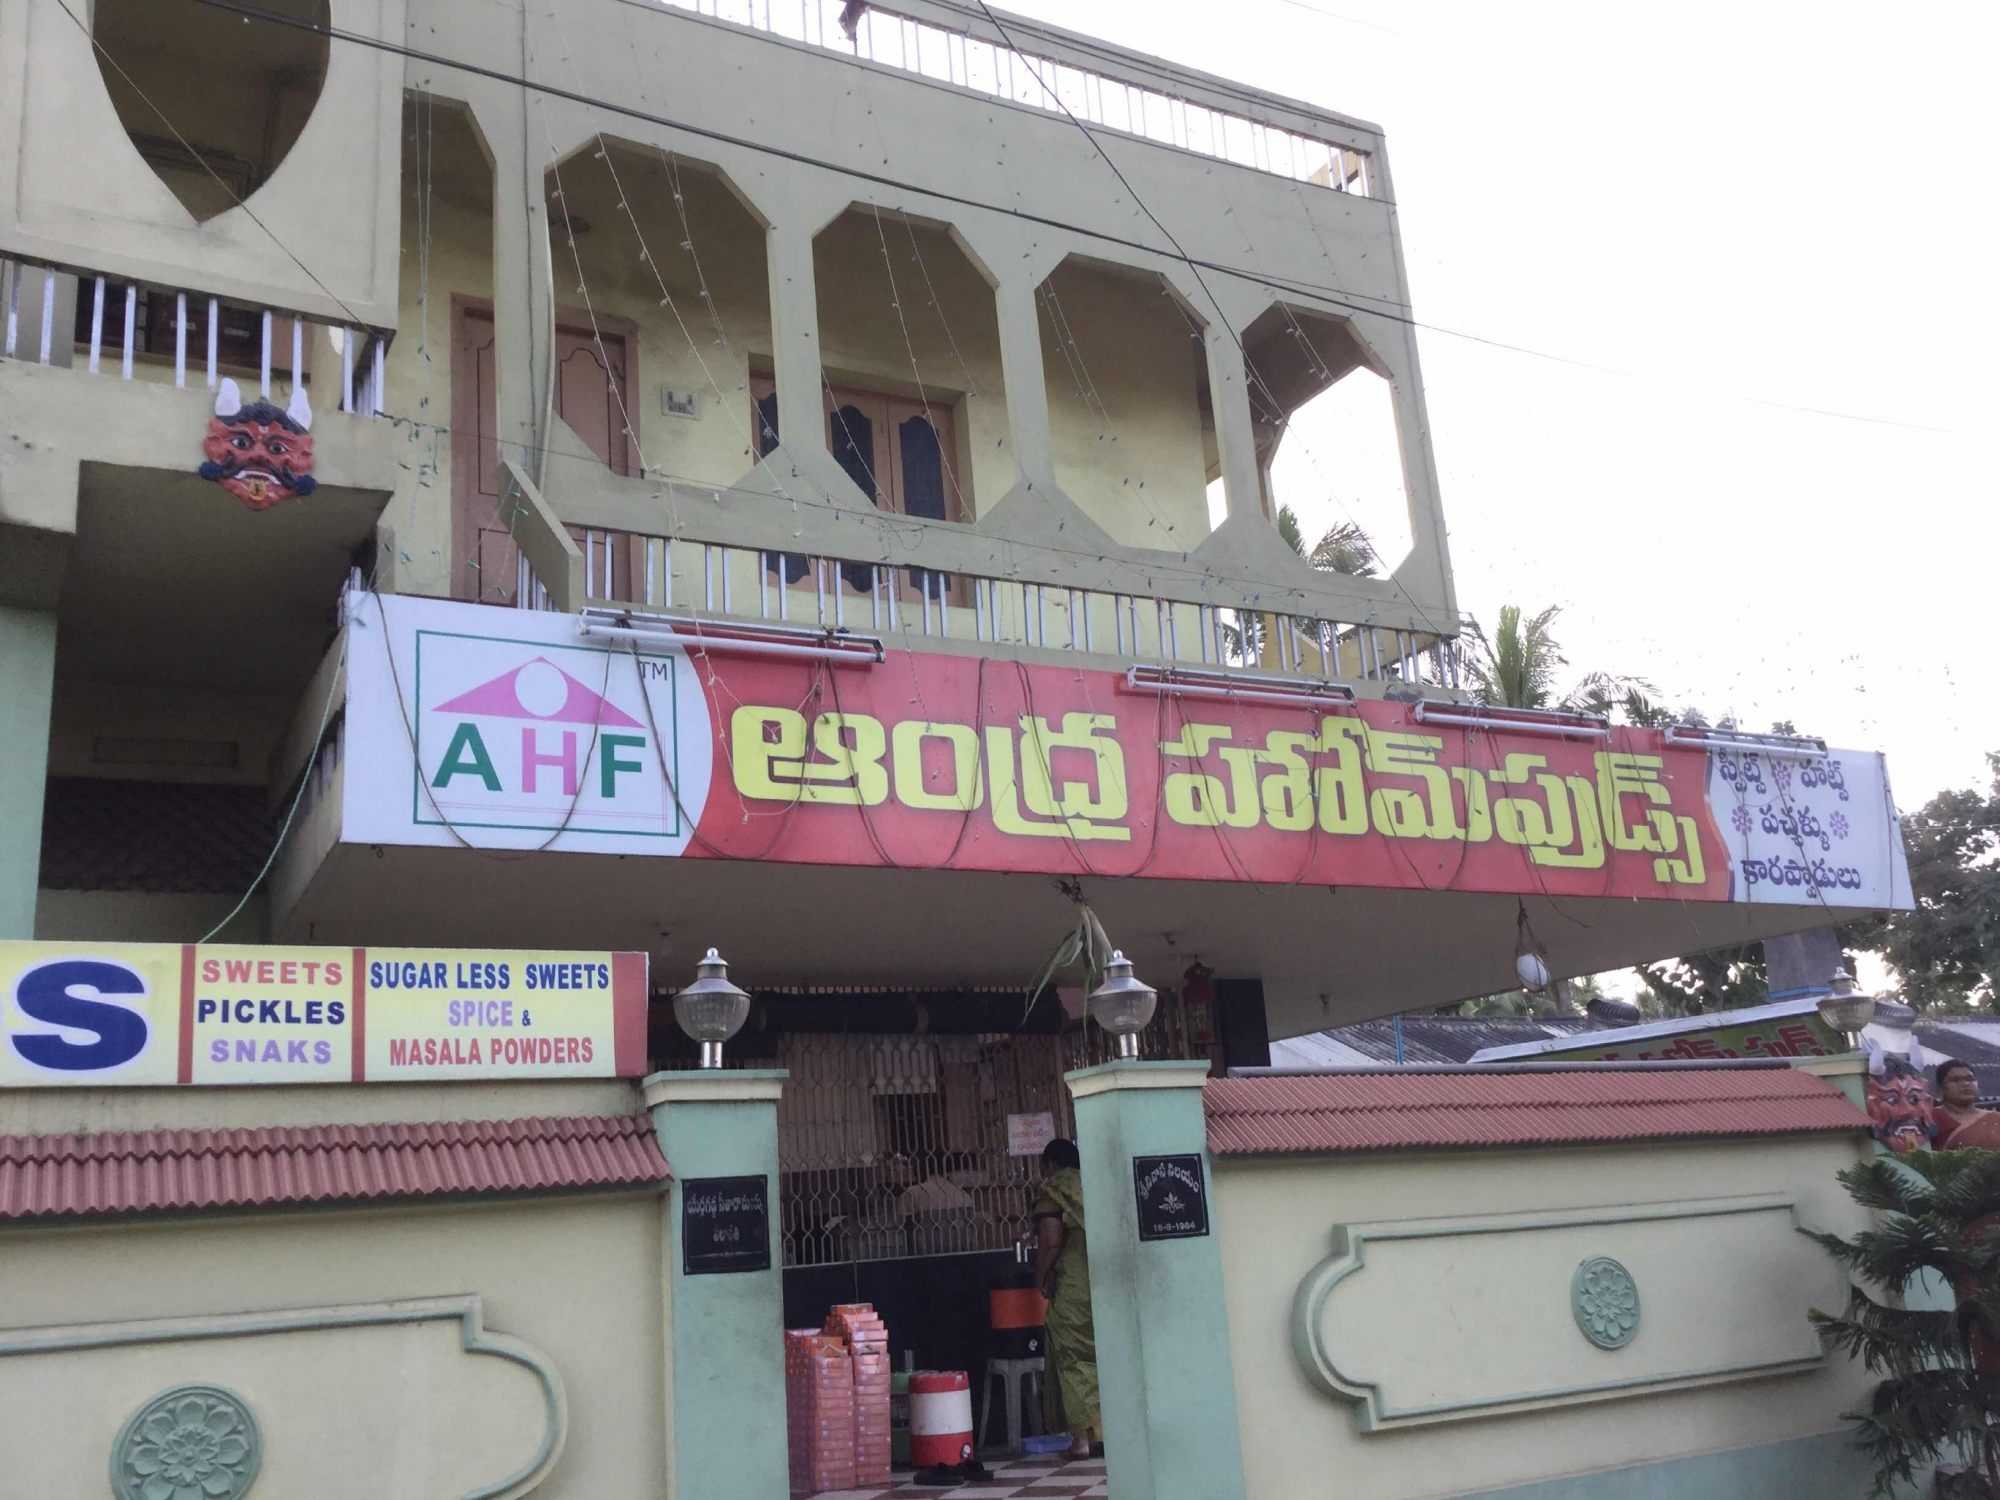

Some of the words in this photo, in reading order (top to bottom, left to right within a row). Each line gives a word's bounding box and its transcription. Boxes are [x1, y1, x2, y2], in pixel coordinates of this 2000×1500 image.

[638, 660, 668, 682] TM
[431, 722, 646, 798] AHF
[202, 960, 343, 986] SWEETS
[369, 961, 448, 989] SUGAR
[456, 962, 511, 990] LESS
[525, 963, 609, 990] SWEETS
[11, 960, 148, 1071] S
[198, 1000, 346, 1025] PICKLES
[448, 1000, 514, 1027] SPICE
[521, 1010, 531, 1027] &
[210, 1039, 332, 1064] SNAKS
[389, 1038, 486, 1066] MASALA
[489, 1037, 594, 1066] POWDERS
